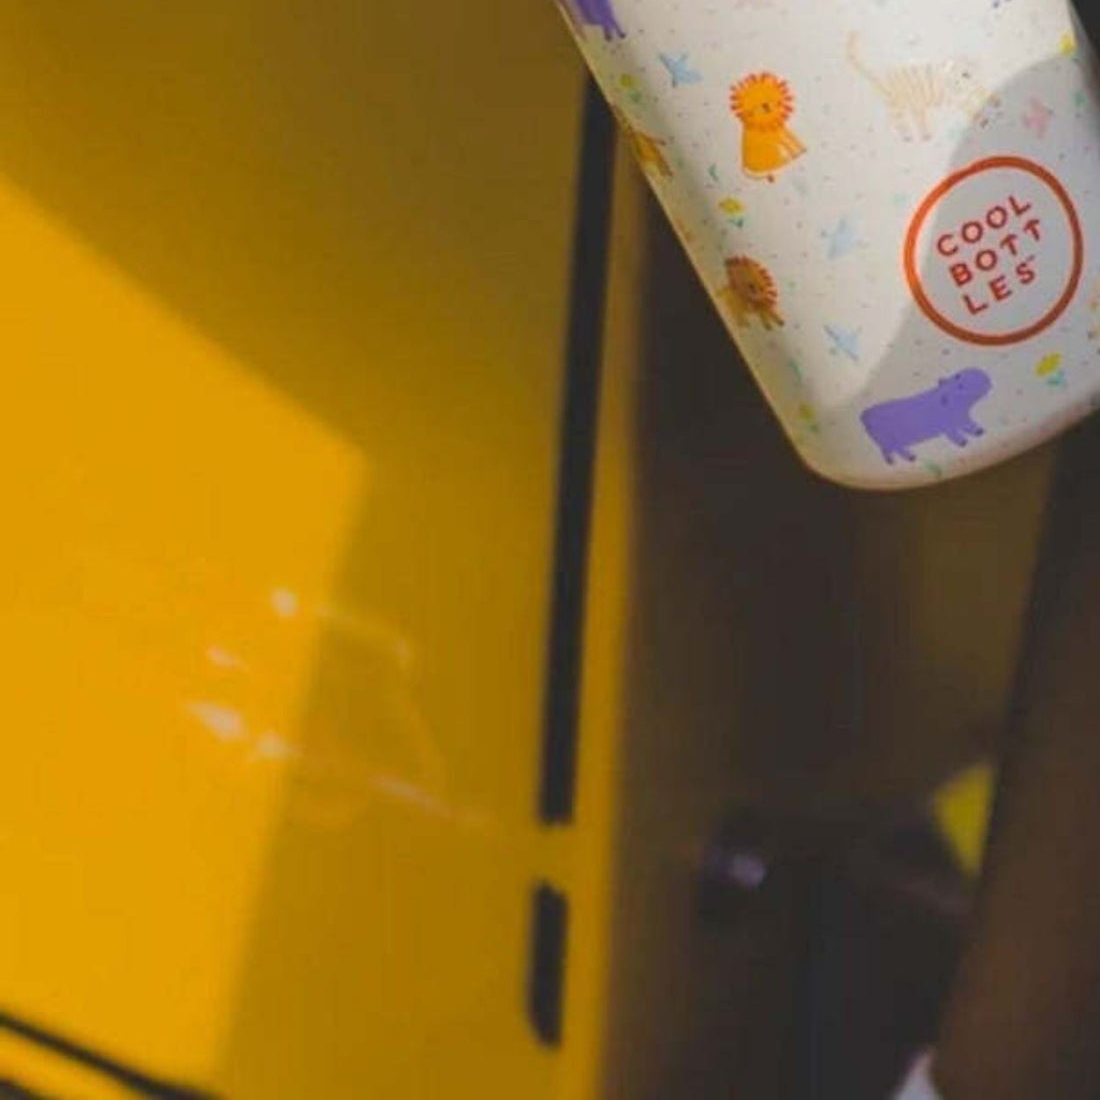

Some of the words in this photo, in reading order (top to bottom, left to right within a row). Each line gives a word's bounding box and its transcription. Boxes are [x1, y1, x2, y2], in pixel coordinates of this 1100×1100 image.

[937, 195, 1031, 256] COOL
[949, 218, 1040, 286] BOTT
[963, 261, 1036, 315] LES
